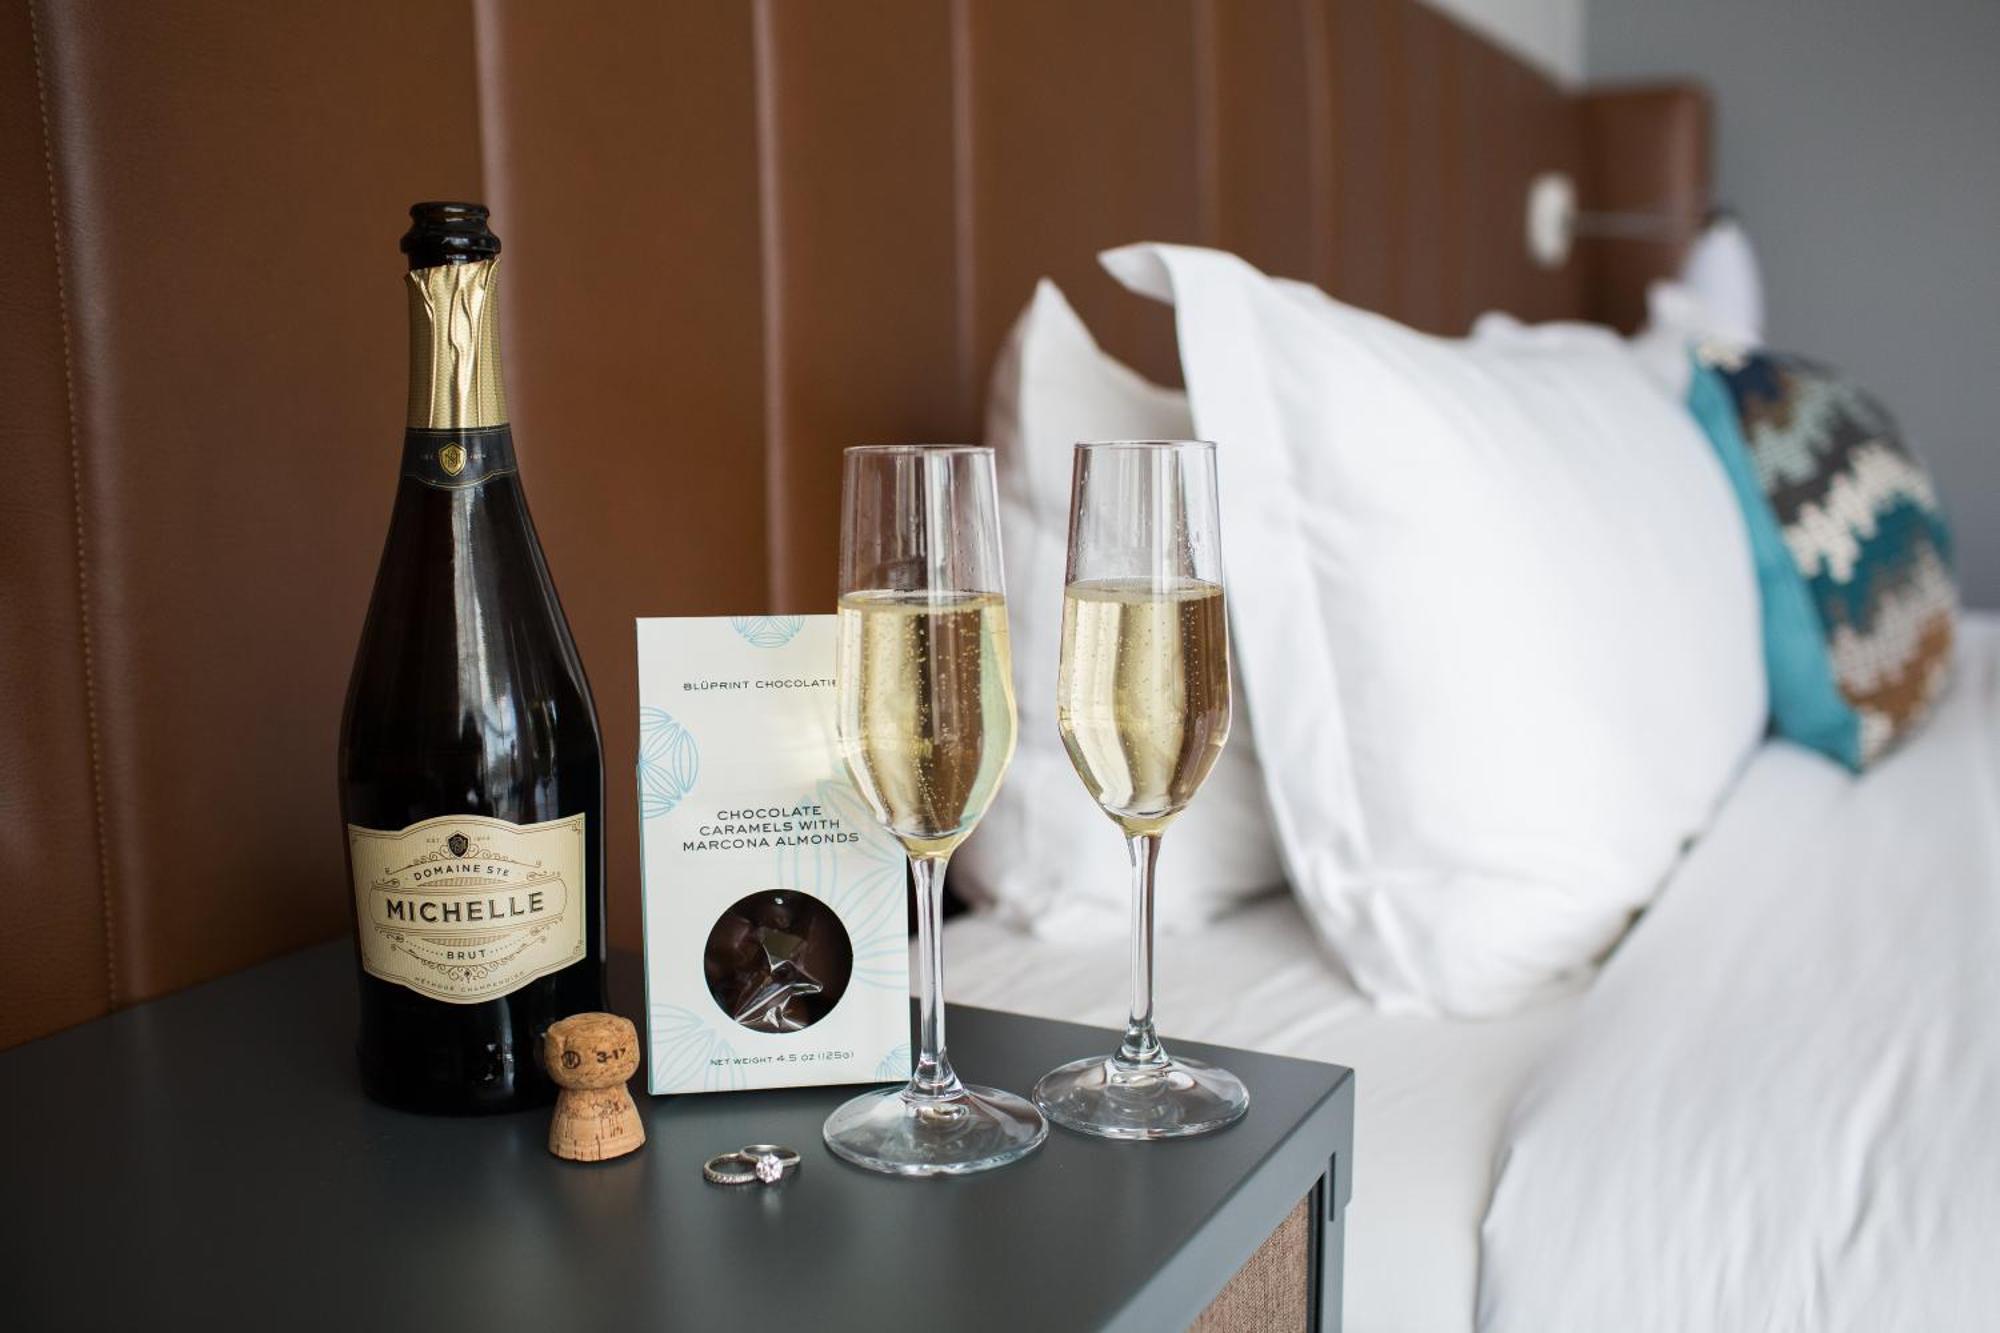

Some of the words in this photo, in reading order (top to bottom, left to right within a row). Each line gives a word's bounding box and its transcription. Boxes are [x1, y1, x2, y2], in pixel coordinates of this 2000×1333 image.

[683, 681, 749, 691] BLÜPRINT
[717, 806, 822, 820] CHOCOLATE
[699, 822, 793, 836] CARAMELS
[799, 819, 840, 831] WITH
[683, 837, 770, 852] MARCONA
[776, 833, 860, 846] ALMONDS
[414, 864, 481, 881] DOMAINE
[487, 866, 510, 876] STE
[386, 891, 544, 923] MICHELLE
[447, 950, 486, 960] BRUT
[710, 1058, 730, 1066] NET
[733, 1056, 773, 1065] WEIGHT
